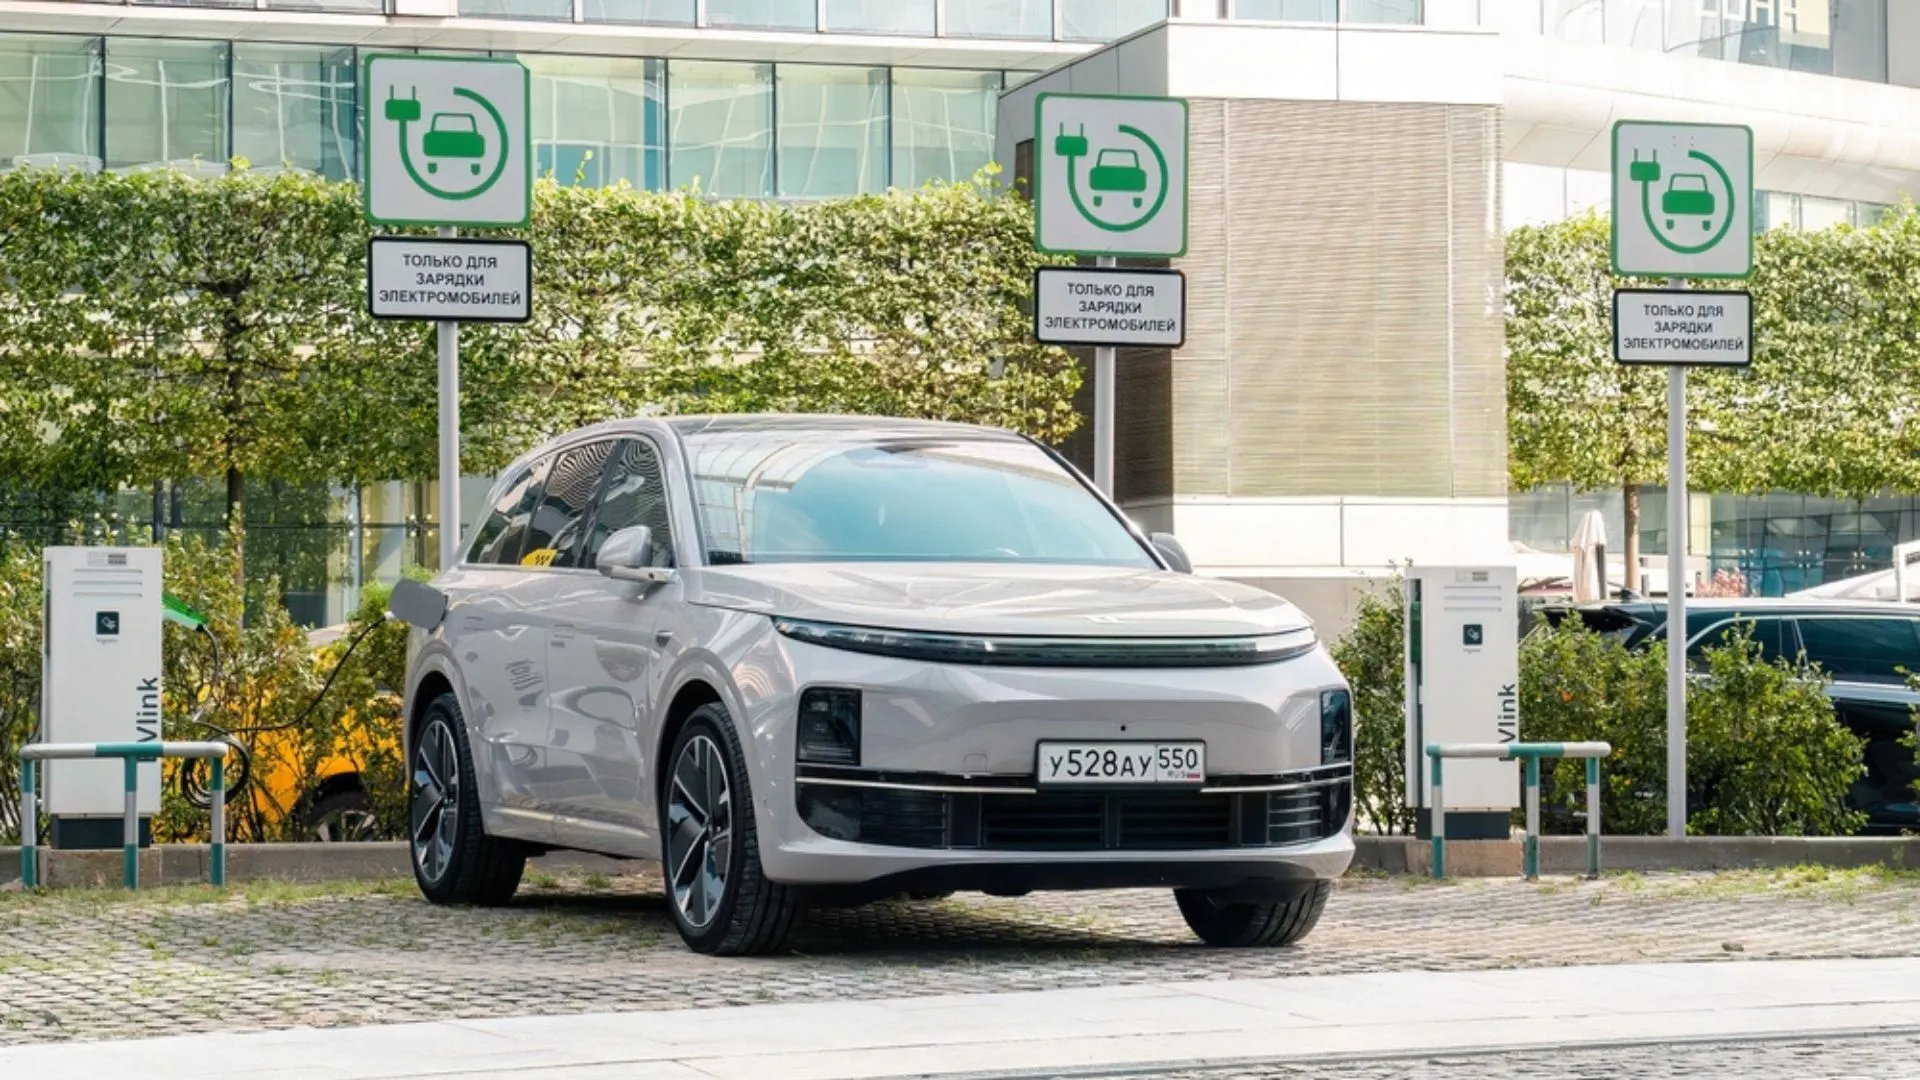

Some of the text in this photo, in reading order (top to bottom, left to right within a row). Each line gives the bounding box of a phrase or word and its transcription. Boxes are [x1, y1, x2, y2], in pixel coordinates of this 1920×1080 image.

[403, 254, 497, 269] ТОЛЬКО ДЛЯ
[416, 272, 485, 287] ЗАРЯДКИ
[1067, 283, 1155, 297] ТОЛЬКО ДЛЯ
[379, 290, 521, 305] ЭЛЕКТРОМОБИЛЕЙ
[1079, 301, 1142, 314] ЗАРЯДКИ
[1643, 304, 1724, 318] ТОЛЬКО ДЛЯ
[1045, 316, 1176, 331] ЭЛЕКТРОМОБИЛЕЙ
[1654, 322, 1713, 334] ЗАРЯДКИ
[1623, 337, 1744, 351] ЭЛЕКТРОМОБИЛЕЙ
[1159, 748, 1198, 769] 550
